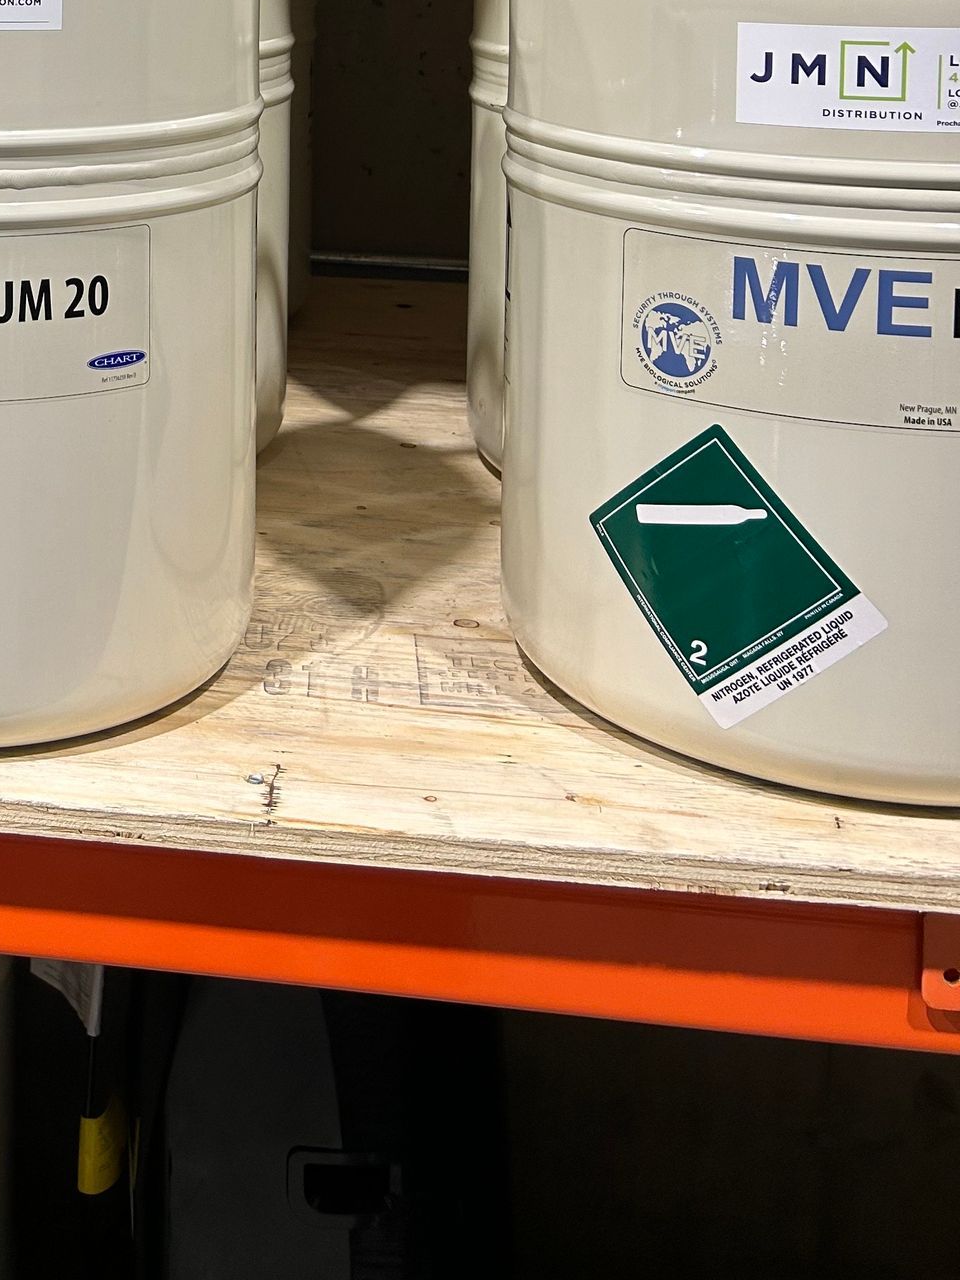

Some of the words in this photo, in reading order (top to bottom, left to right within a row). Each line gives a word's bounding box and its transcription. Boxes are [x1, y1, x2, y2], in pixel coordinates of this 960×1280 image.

[822, 108, 923, 120] DISTRIBUTION
[64, 274, 110, 319] 20
[732, 256, 932, 338] MVE
[632, 295, 656, 328] SECURITY
[658, 292, 700, 308] THROUGH
[699, 306, 723, 345] SYSTEMS
[648, 326, 706, 359] MVE
[94, 353, 140, 366] CHART
[636, 347, 645, 363] MVE
[643, 363, 683, 388] BIOLOGICAL
[899, 403, 915, 413] New
[917, 405, 943, 416] Prague,
[945, 406, 957, 415] MN
[904, 416, 926, 426] Made
[927, 417, 935, 426] in
[937, 418, 952, 426] USA
[690, 640, 707, 666] 2
[711, 671, 758, 702] NITROGEN,
[756, 631, 822, 674] REFRIGERATED
[821, 610, 854, 635] LIQUID
[732, 681, 762, 704] AZOTE
[762, 661, 797, 687] LIQUIDE
[796, 629, 848, 666] RÉFRIGÉRÉ
[776, 678, 793, 692] UN
[793, 665, 814, 683] 1977
